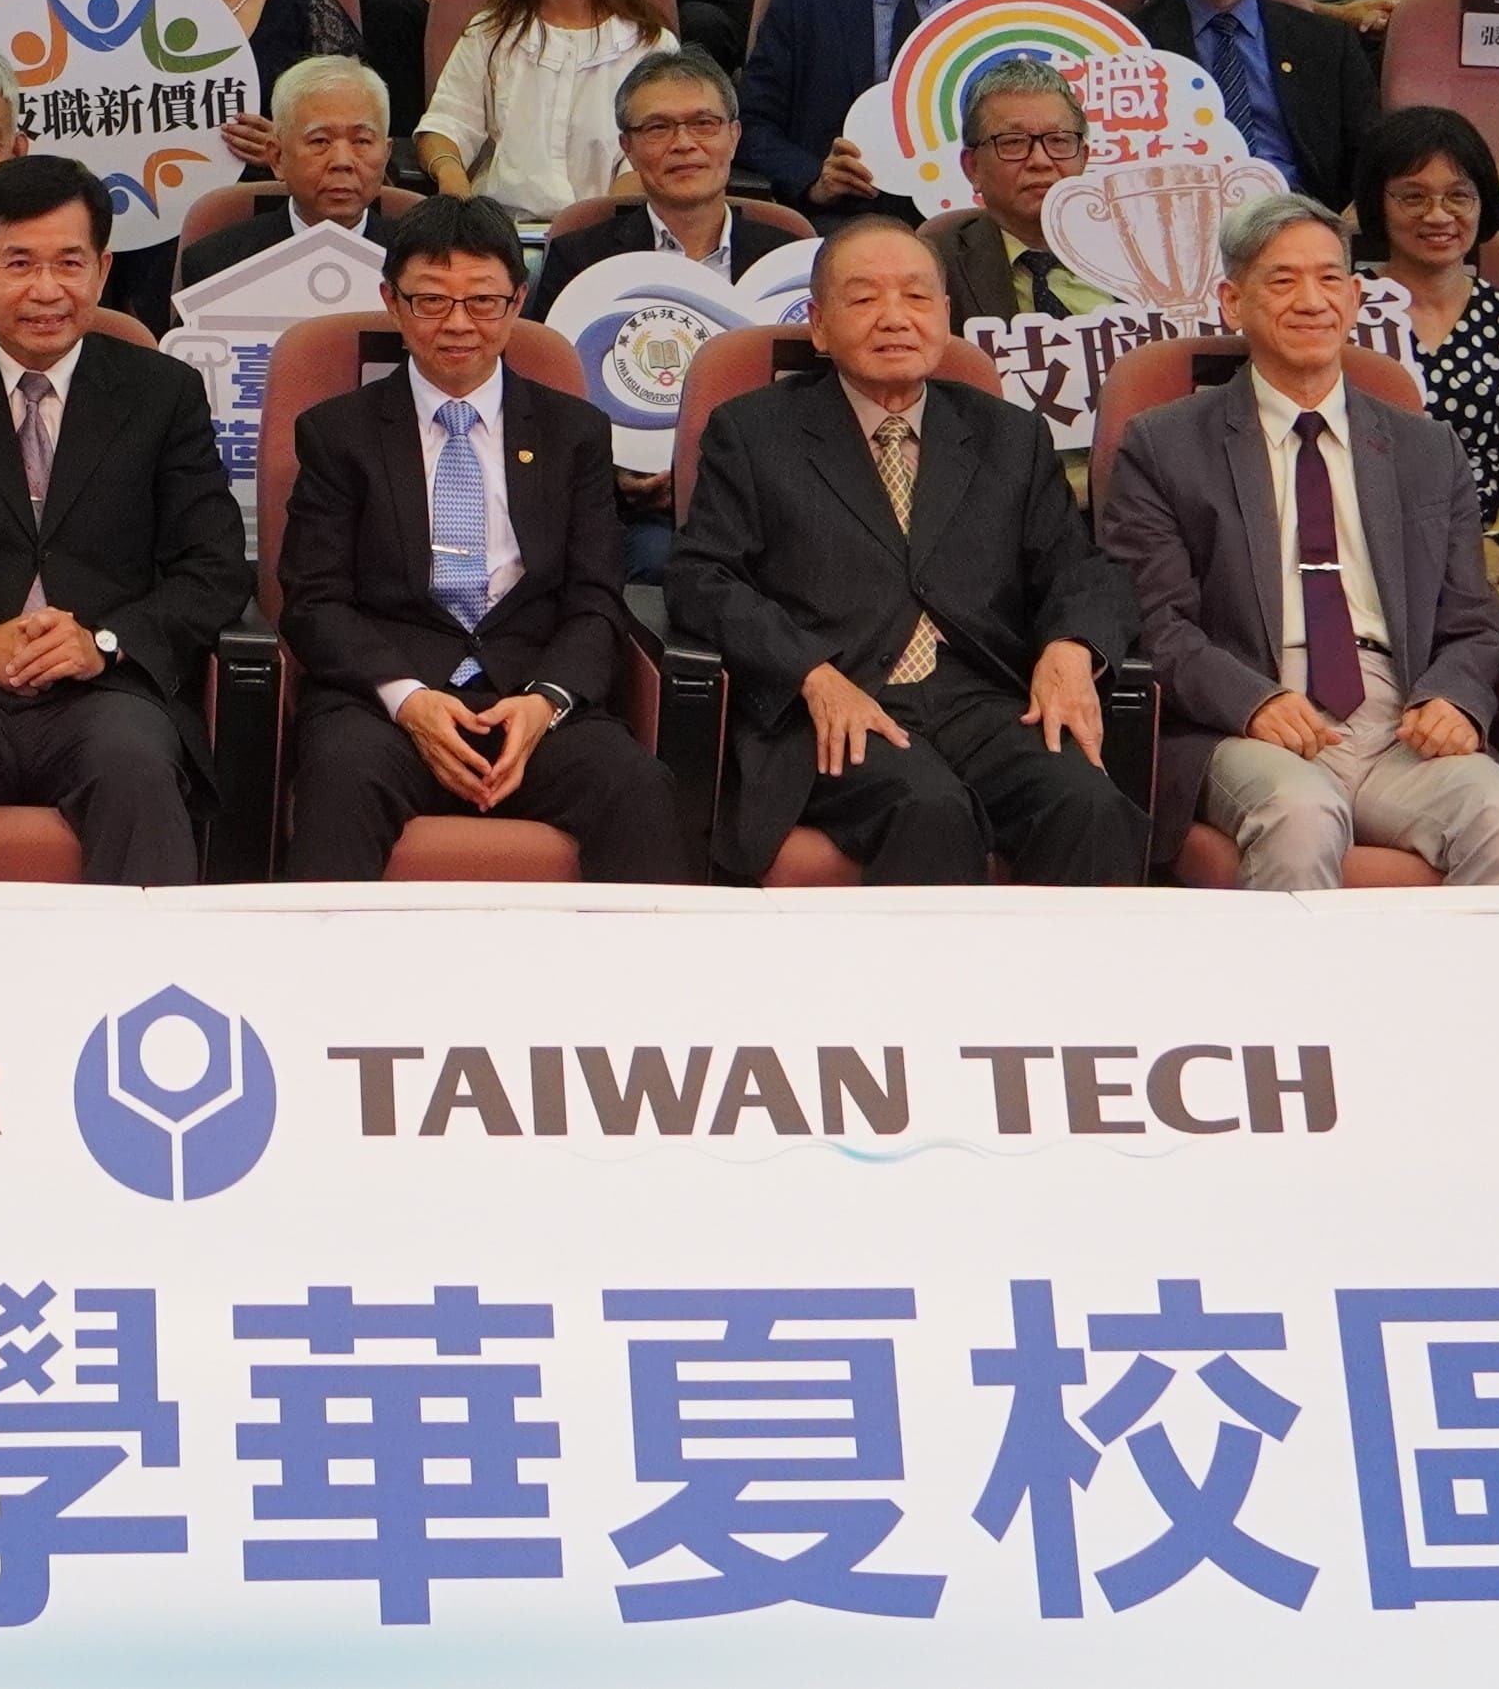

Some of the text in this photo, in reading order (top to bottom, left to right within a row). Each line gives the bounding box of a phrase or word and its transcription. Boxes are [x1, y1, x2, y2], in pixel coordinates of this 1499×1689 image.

[1050, 54, 1162, 121] 職
[327, 1046, 909, 1136] TAIWAN
[960, 1045, 1338, 1134] TECH
